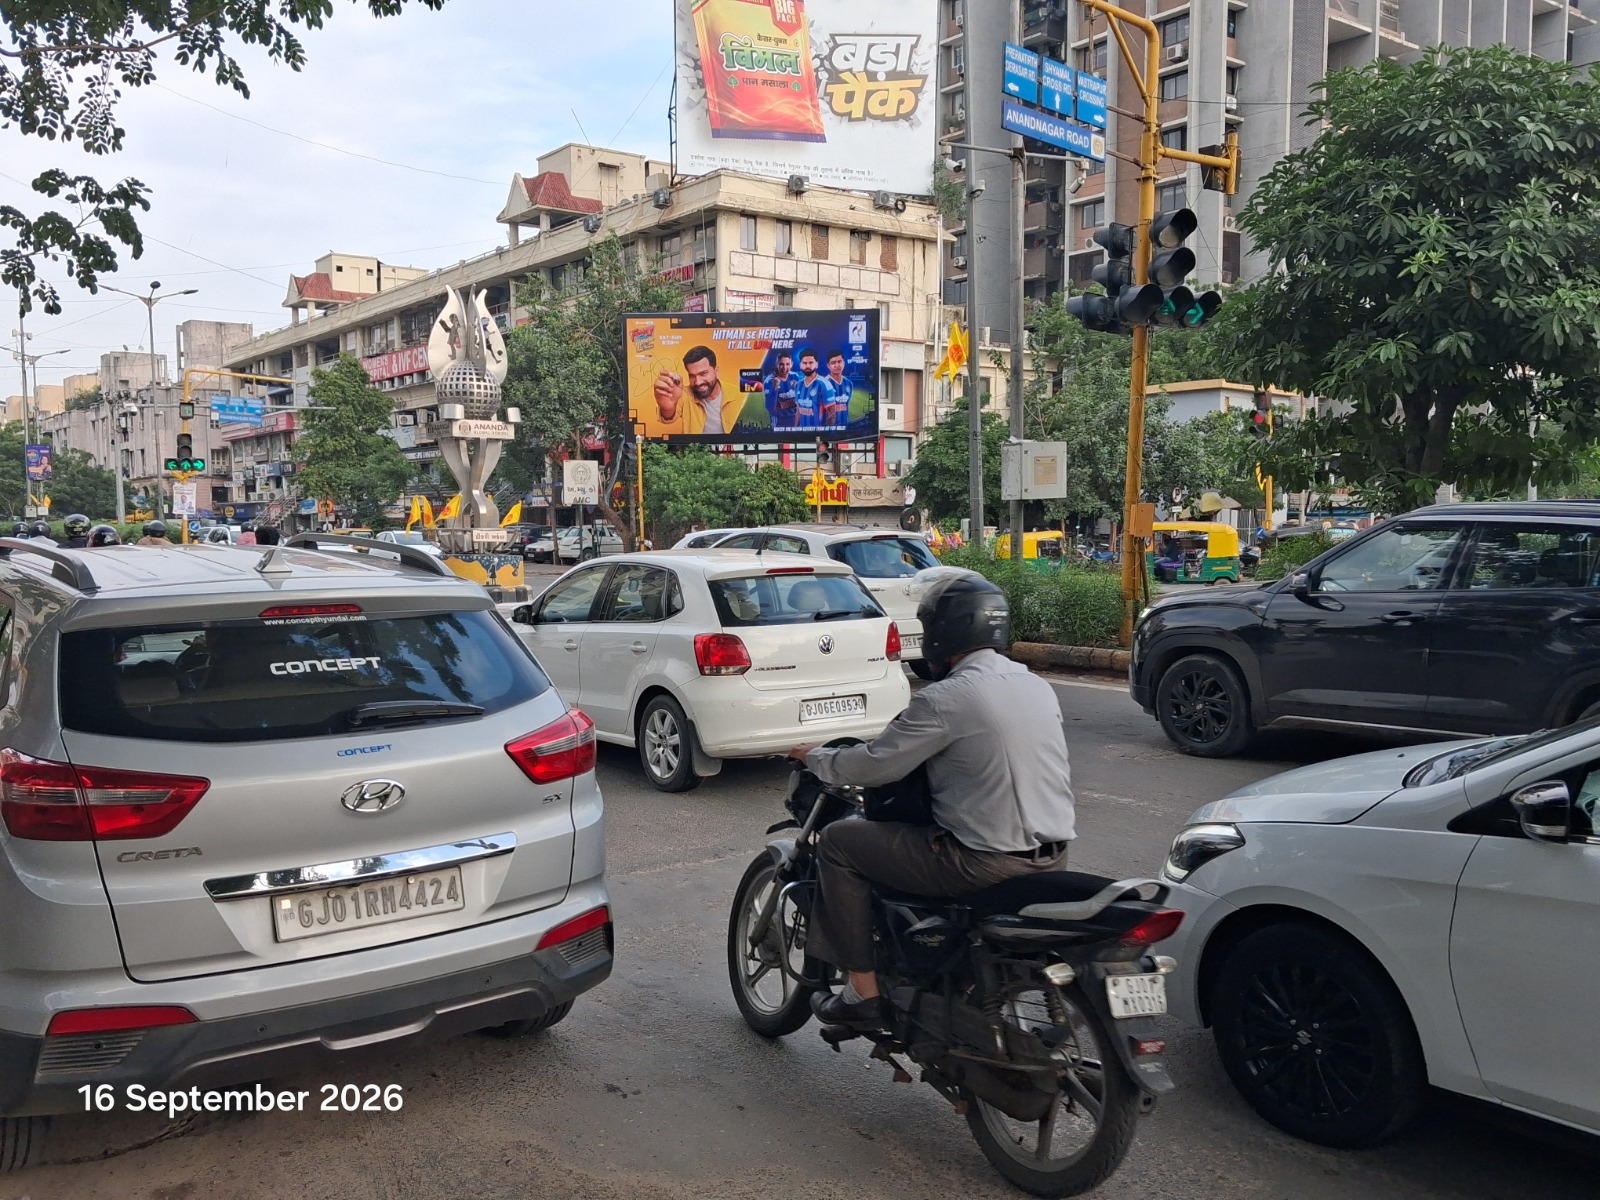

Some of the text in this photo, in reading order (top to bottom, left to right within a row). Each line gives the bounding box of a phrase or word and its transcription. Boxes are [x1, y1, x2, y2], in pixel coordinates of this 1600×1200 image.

[775, 0, 796, 15] BIG
[776, 14, 797, 24] PACK
[832, 35, 919, 81] बड़ा
[1044, 62, 1071, 82] SHYAMAL
[742, 77, 788, 88] पान मसाला
[1042, 76, 1062, 91] CROSS
[1078, 75, 1106, 95] VASTRAPUR
[826, 72, 922, 118] पैक
[1080, 90, 1105, 108] CROSSING
[1006, 109, 1089, 148] ANANDNAGAR ROAD
[713, 328, 808, 340] HITMAN SE HEROES TAK
[728, 341, 736, 350] IT
[737, 341, 751, 350] ALL
[772, 340, 794, 349] HERE
[392, 354, 398, 374] &
[399, 350, 411, 372] IVF
[412, 346, 429, 369] CEN
[474, 423, 509, 431] ANANDA
[264, 615, 367, 626] www.concepthyundai.com
[270, 657, 381, 675] CONCEPT
[337, 744, 392, 757] CONCEPT
[117, 846, 203, 862] CRETA
